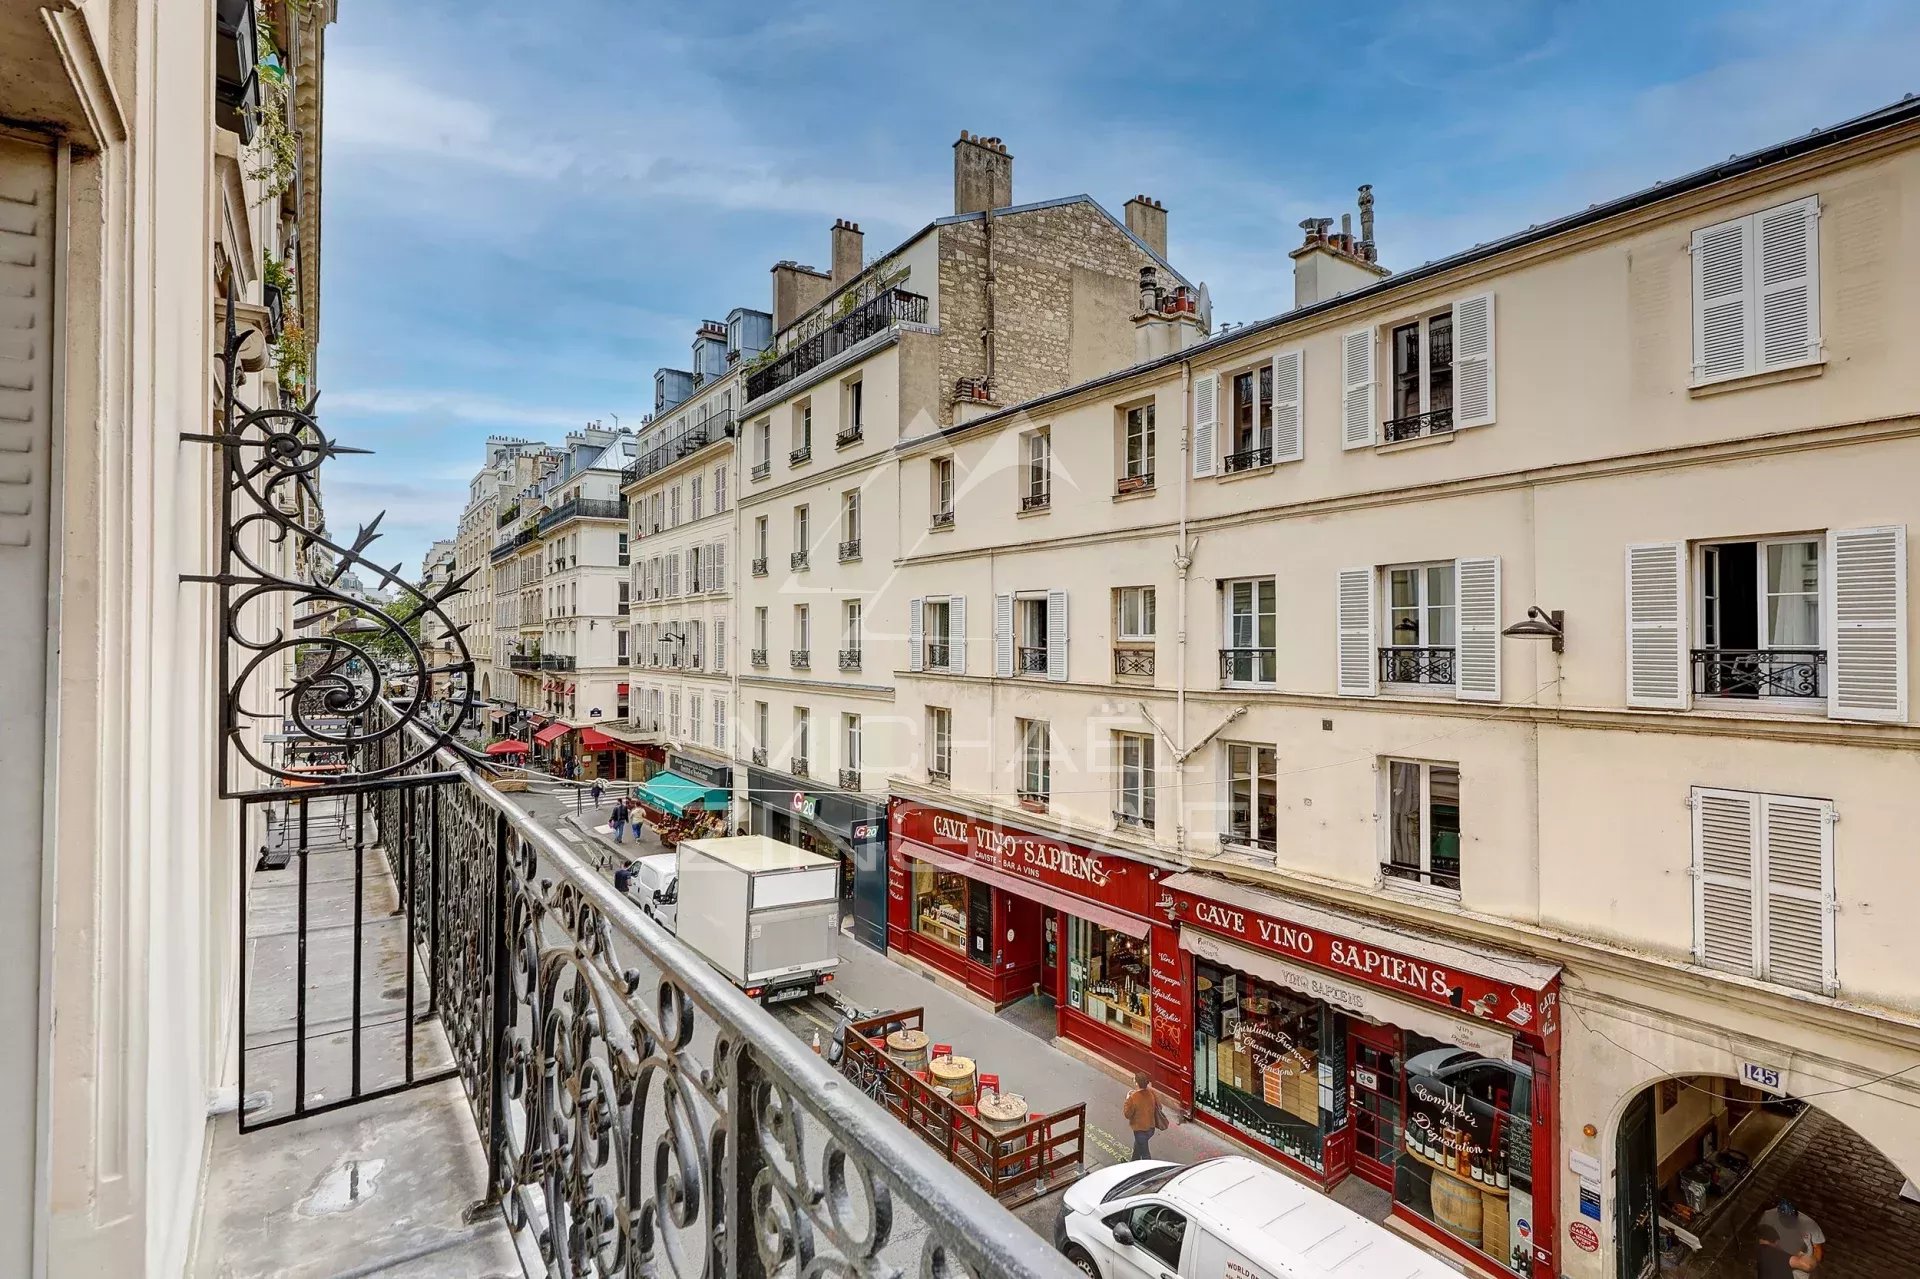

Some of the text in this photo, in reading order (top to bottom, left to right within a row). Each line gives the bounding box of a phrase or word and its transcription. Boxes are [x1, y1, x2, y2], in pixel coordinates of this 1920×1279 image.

[933, 815, 1104, 885] CAVE VINO SAPIENS
[974, 851, 997, 864] CAVISTE
[1003, 860, 1016, 870] BAR
[1023, 866, 1040, 878] VINS
[1158, 952, 1175, 966] Vins
[1196, 902, 1448, 996] CAVE VINO SAPIENS
[1311, 980, 1364, 1008] SAPIENS
[1229, 1020, 1276, 1040] Spiritueux
[1242, 1033, 1292, 1064] Champagne
[1747, 1064, 1777, 1086] 145
[1414, 1083, 1478, 1128] Comptoir
[1411, 1112, 1483, 1154] Dégustation
[1226, 1261, 1250, 1278] WORLD
